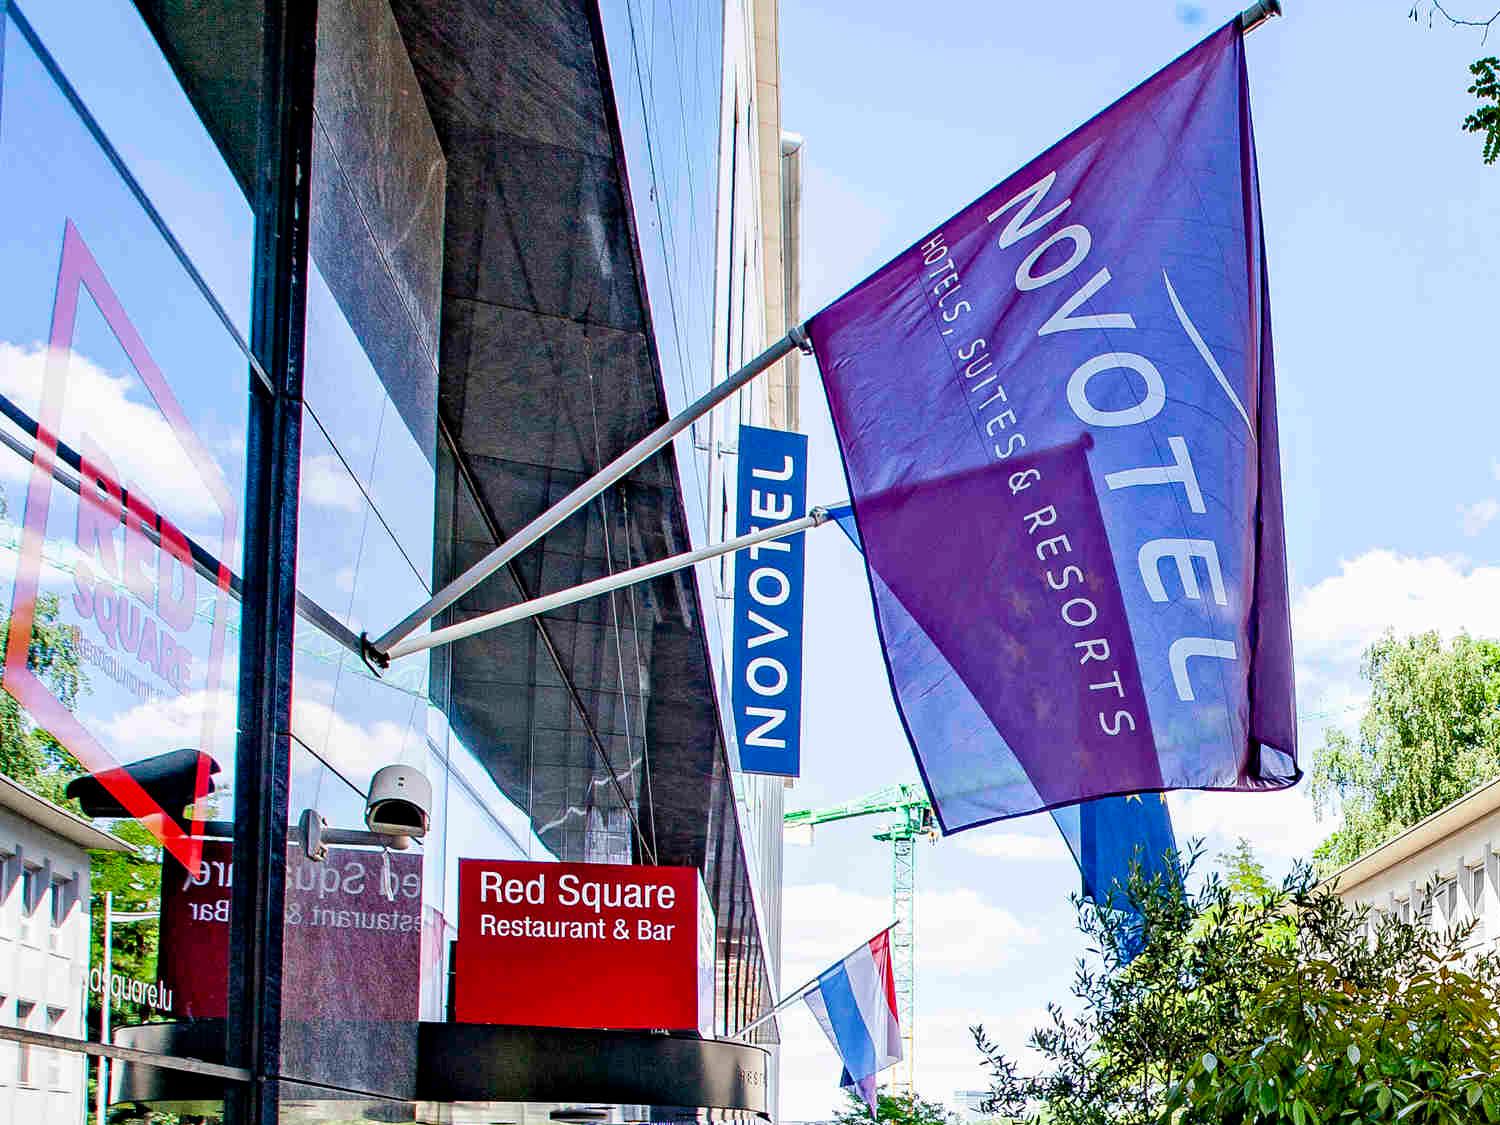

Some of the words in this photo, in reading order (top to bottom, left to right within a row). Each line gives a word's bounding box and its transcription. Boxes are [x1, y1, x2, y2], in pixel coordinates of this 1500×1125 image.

[76, 432, 197, 633] RED
[920, 232, 973, 336] HOTELS,
[956, 337, 1027, 460] SUITES
[1007, 469, 1041, 496] &
[1024, 505, 1136, 737] RESORTS
[987, 170, 1237, 702] NOVOTEL
[744, 454, 794, 749] NOVOTEL
[90, 961, 173, 1012] dsquare.lu
[479, 871, 545, 905] Red
[557, 874, 676, 914] Square
[480, 914, 607, 940] Restaurant
[612, 918, 630, 940] &
[637, 919, 676, 941] Bar
